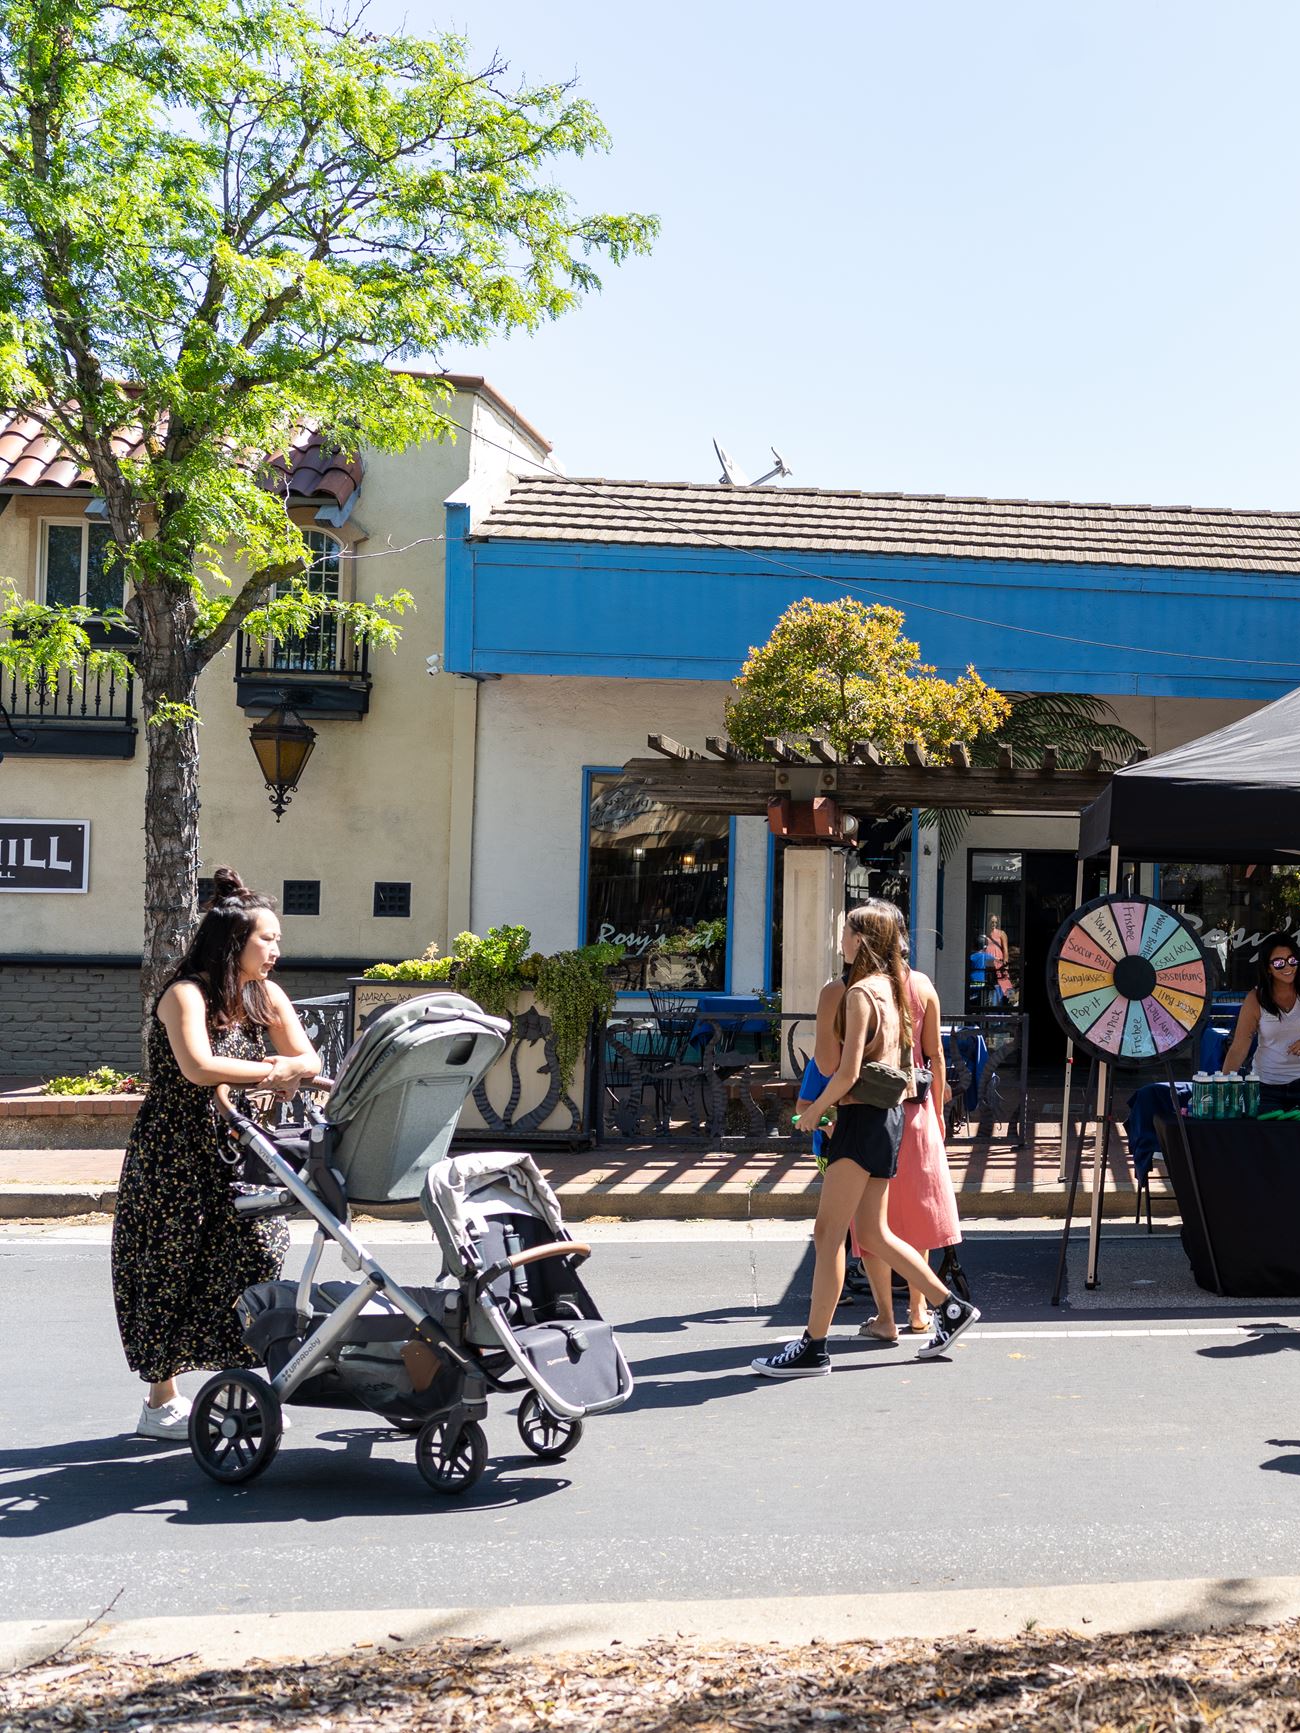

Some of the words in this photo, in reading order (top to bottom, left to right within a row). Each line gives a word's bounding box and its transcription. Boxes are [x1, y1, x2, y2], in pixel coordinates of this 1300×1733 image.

[0, 836, 72, 872] ILL
[1094, 912, 1107, 932] You
[1103, 930, 1118, 950] Pick
[1123, 906, 1136, 942] Frisbee
[1151, 914, 1169, 937] Water
[597, 922, 667, 955] Rosy's
[687, 929, 715, 949] at
[1140, 936, 1157, 959] Bottle
[1173, 940, 1194, 956] Day
[1094, 954, 1112, 970] Ball
[1155, 952, 1177, 968] Pass
[1061, 972, 1106, 986] Sunglasses
[1157, 968, 1203, 983] Sunglasses
[1158, 990, 1175, 1006] Ball
[1146, 1001, 1162, 1023] Pack
[1176, 1000, 1199, 1020] Soccer
[1098, 1028, 1115, 1044] You
[1107, 1010, 1123, 1028] Pick
[1131, 1017, 1142, 1055] Frisbee
[258, 1148, 278, 1170] VISTA
